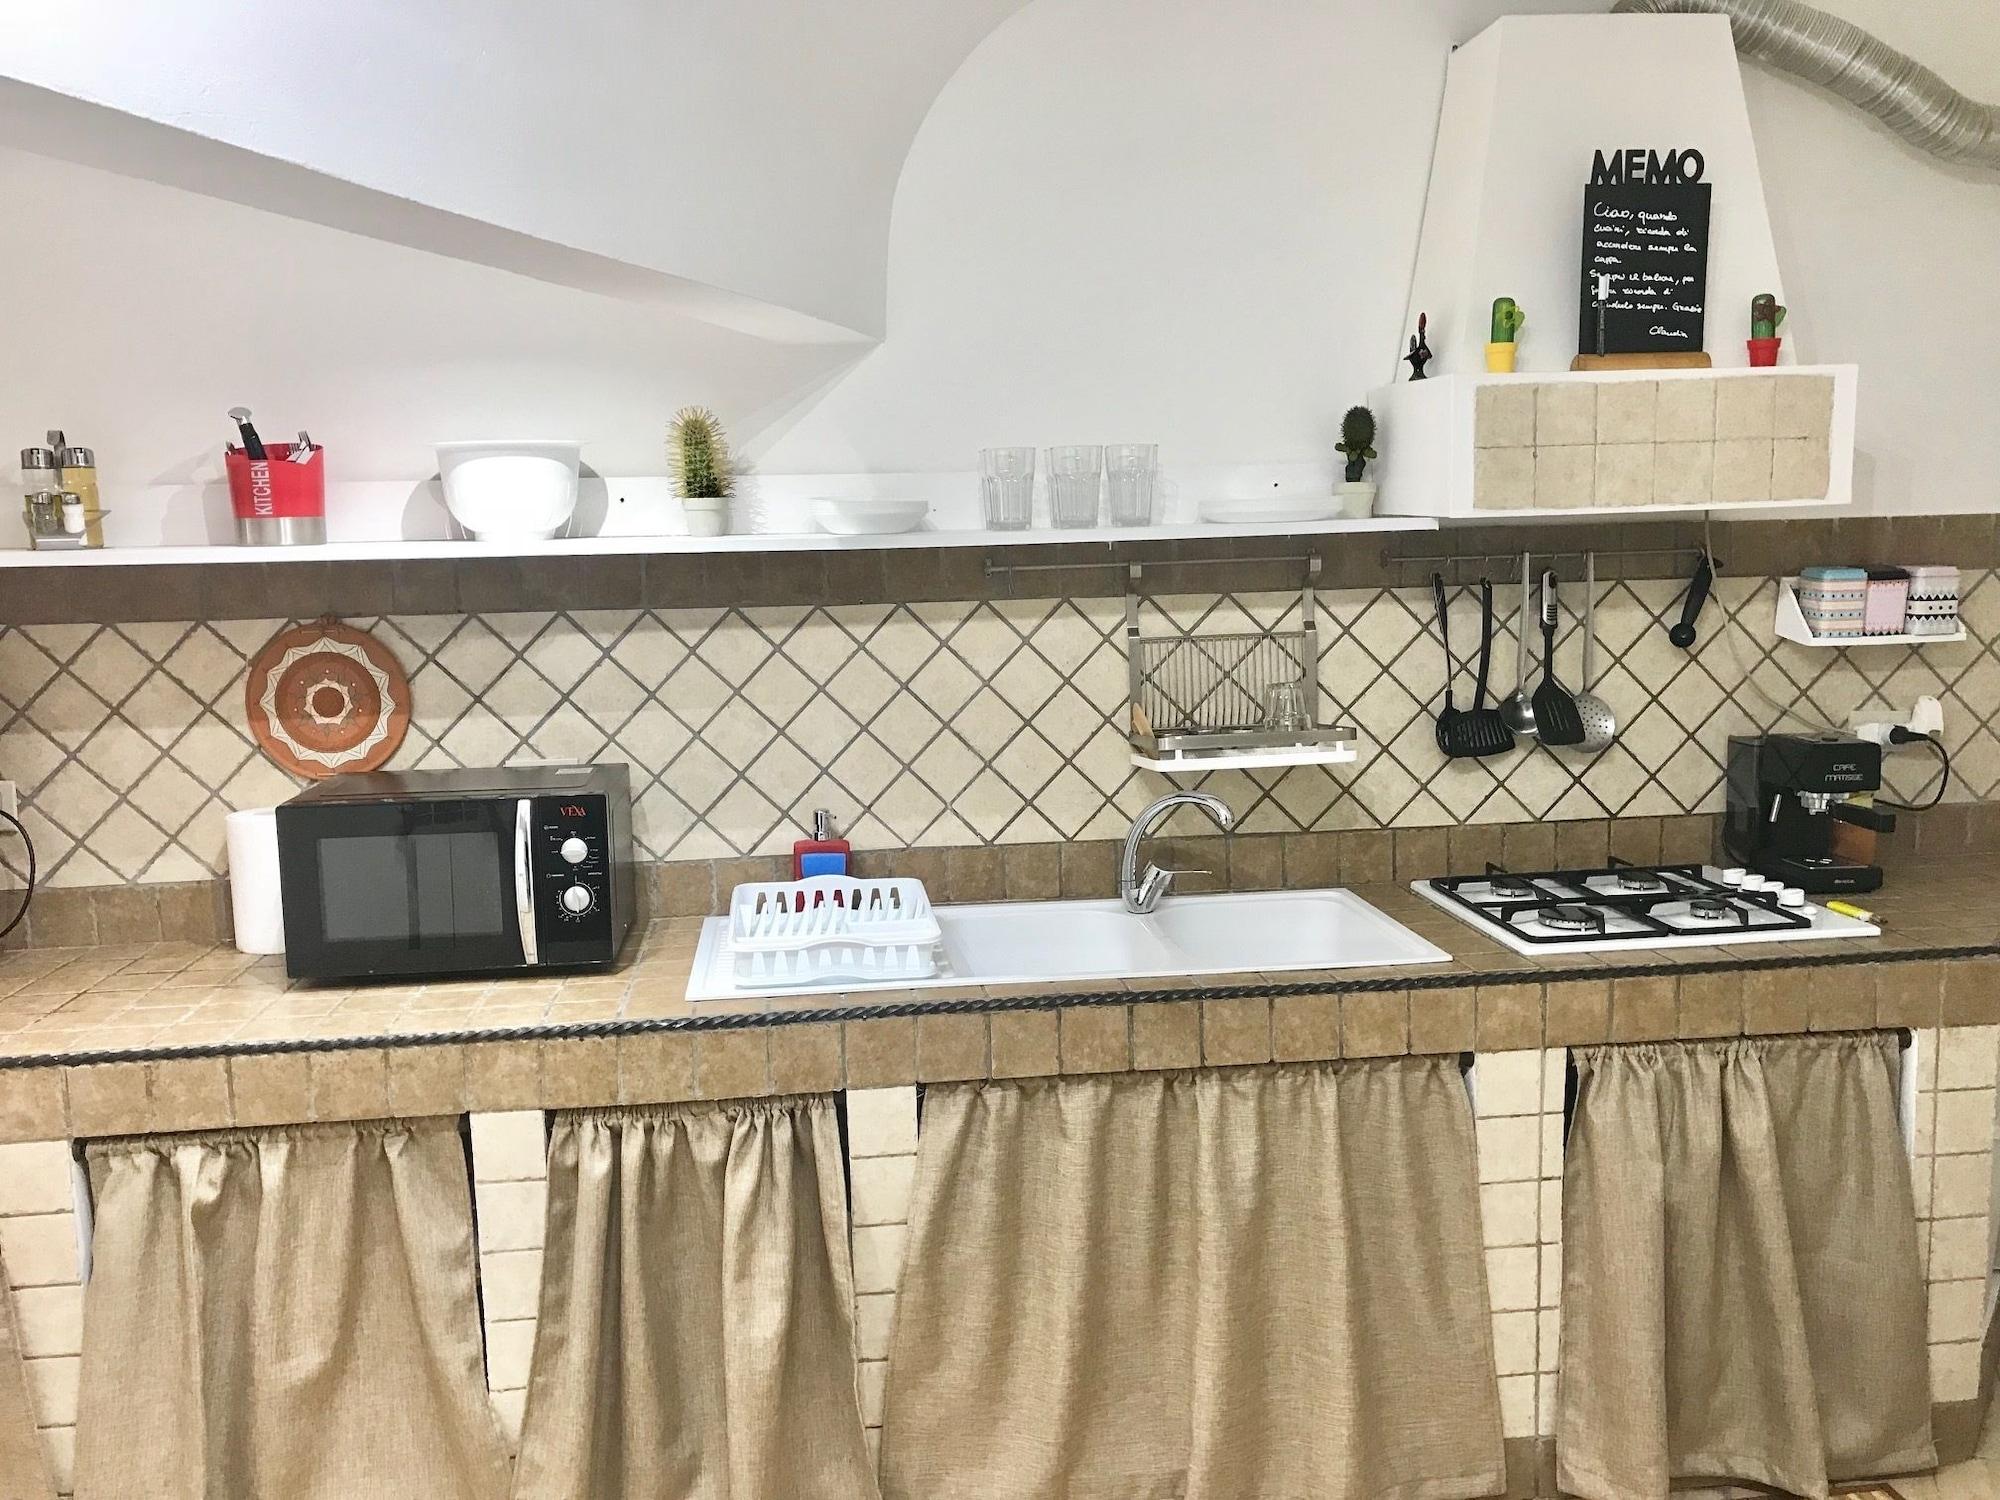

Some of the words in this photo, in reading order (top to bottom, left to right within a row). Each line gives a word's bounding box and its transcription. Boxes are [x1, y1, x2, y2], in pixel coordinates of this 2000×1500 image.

[1590, 149, 1705, 184] MEMO
[1593, 202, 1633, 220] Ciao,
[1637, 211, 1678, 225] quando
[251, 462, 273, 515] KITCHEN
